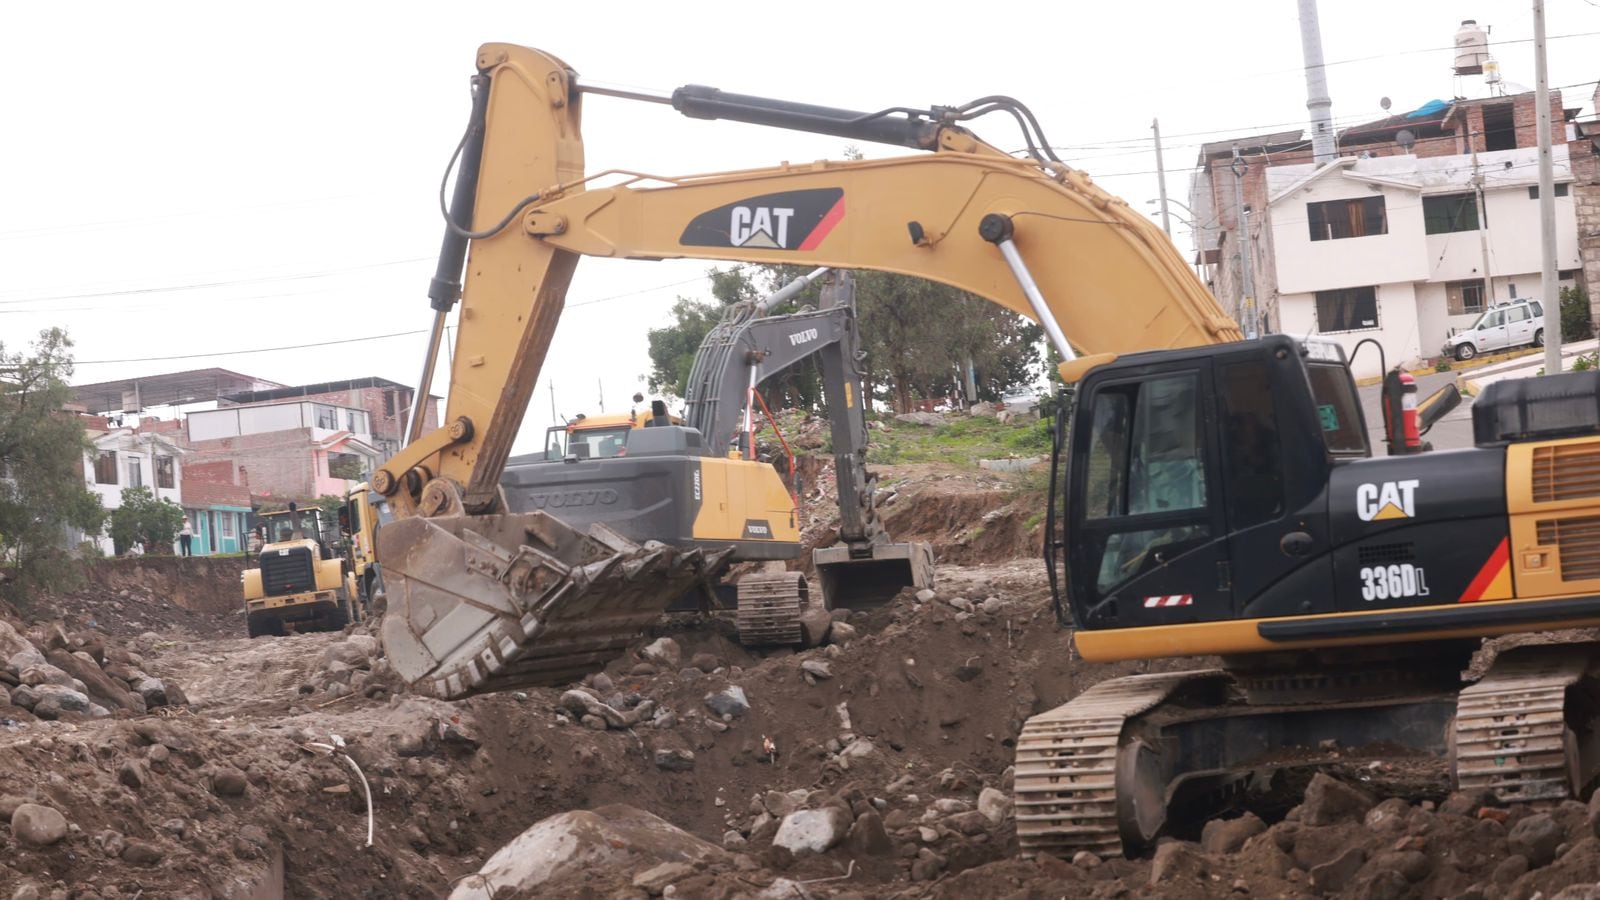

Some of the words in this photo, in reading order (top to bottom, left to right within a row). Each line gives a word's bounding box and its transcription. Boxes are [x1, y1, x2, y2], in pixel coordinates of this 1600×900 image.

[731, 206, 794, 248] CAT
[789, 328, 818, 346] VOLVO
[529, 488, 619, 509] VOLVO
[1357, 479, 1419, 522] CAT
[1360, 563, 1430, 601] 336DL
